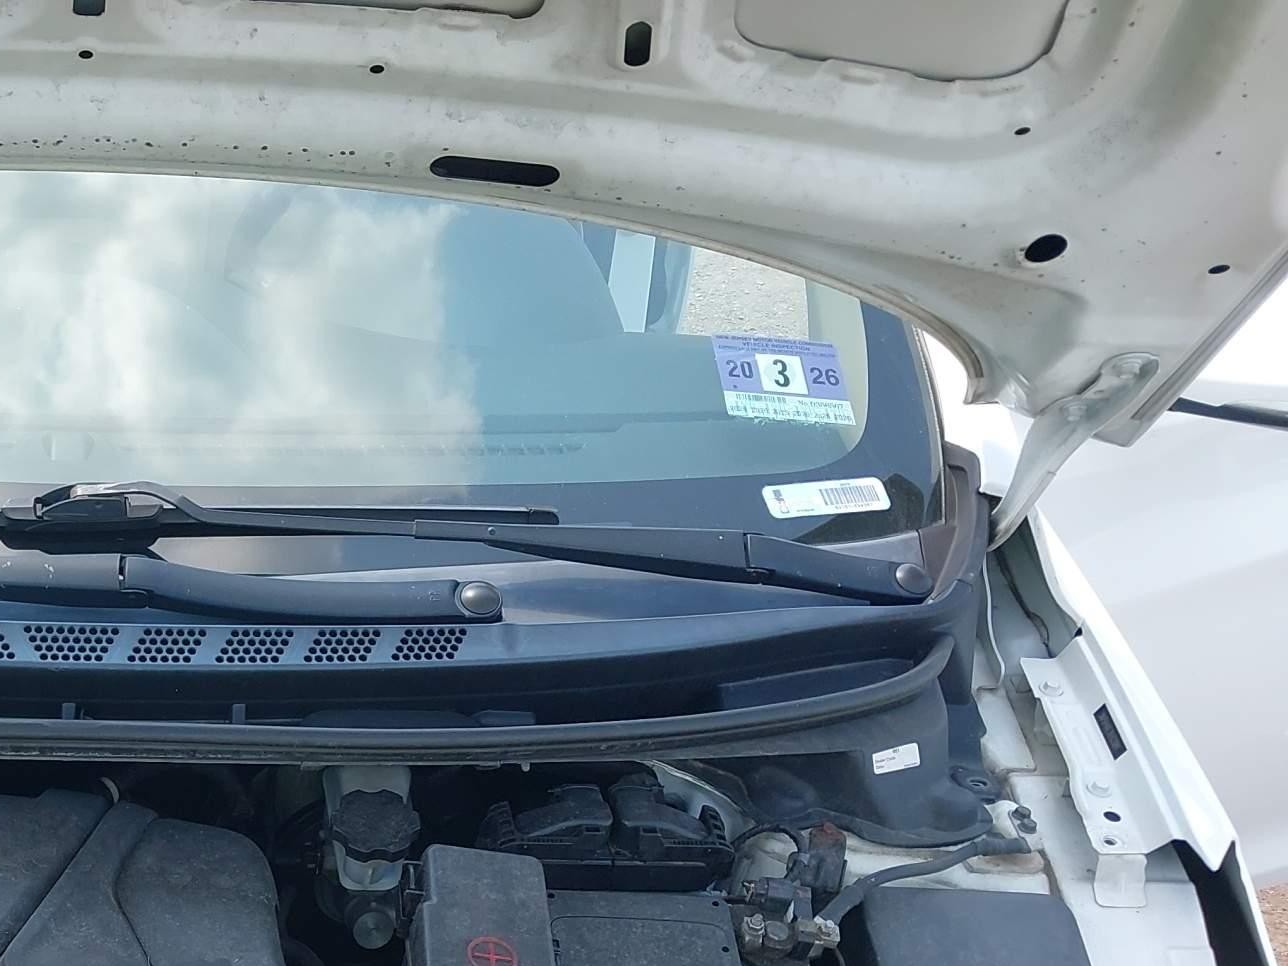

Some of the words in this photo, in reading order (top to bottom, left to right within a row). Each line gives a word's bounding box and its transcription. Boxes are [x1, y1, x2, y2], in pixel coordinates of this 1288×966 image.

[726, 359, 754, 379] 20
[772, 359, 791, 388] 3
[809, 367, 840, 387] 26
